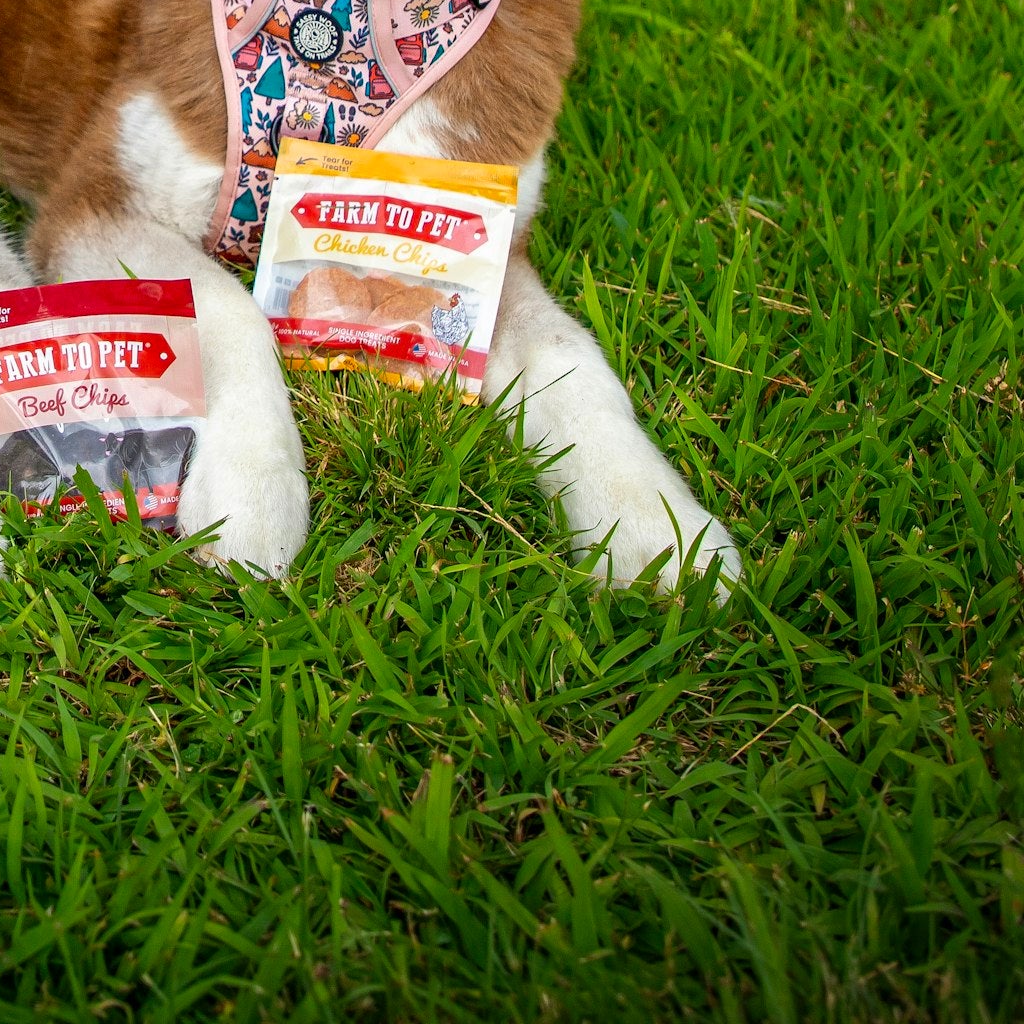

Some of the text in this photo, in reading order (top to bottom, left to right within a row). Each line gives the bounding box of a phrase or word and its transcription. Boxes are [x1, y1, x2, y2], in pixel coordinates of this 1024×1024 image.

[296, 14, 338, 37] SASSY WOOF
[322, 162, 349, 173] Treats!
[323, 156, 353, 166] Tear for
[319, 200, 462, 240] FARM TO PET
[313, 234, 448, 275] Chicken Chips
[293, 329, 320, 337] NATURAL
[328, 326, 401, 345] SINGLE INGREDIENT
[358, 338, 387, 350] TREATS
[61, 342, 93, 372] TO
[97, 340, 144, 369] PET
[428, 350, 447, 360] MADE
[17, 383, 130, 418] Beef Chips
